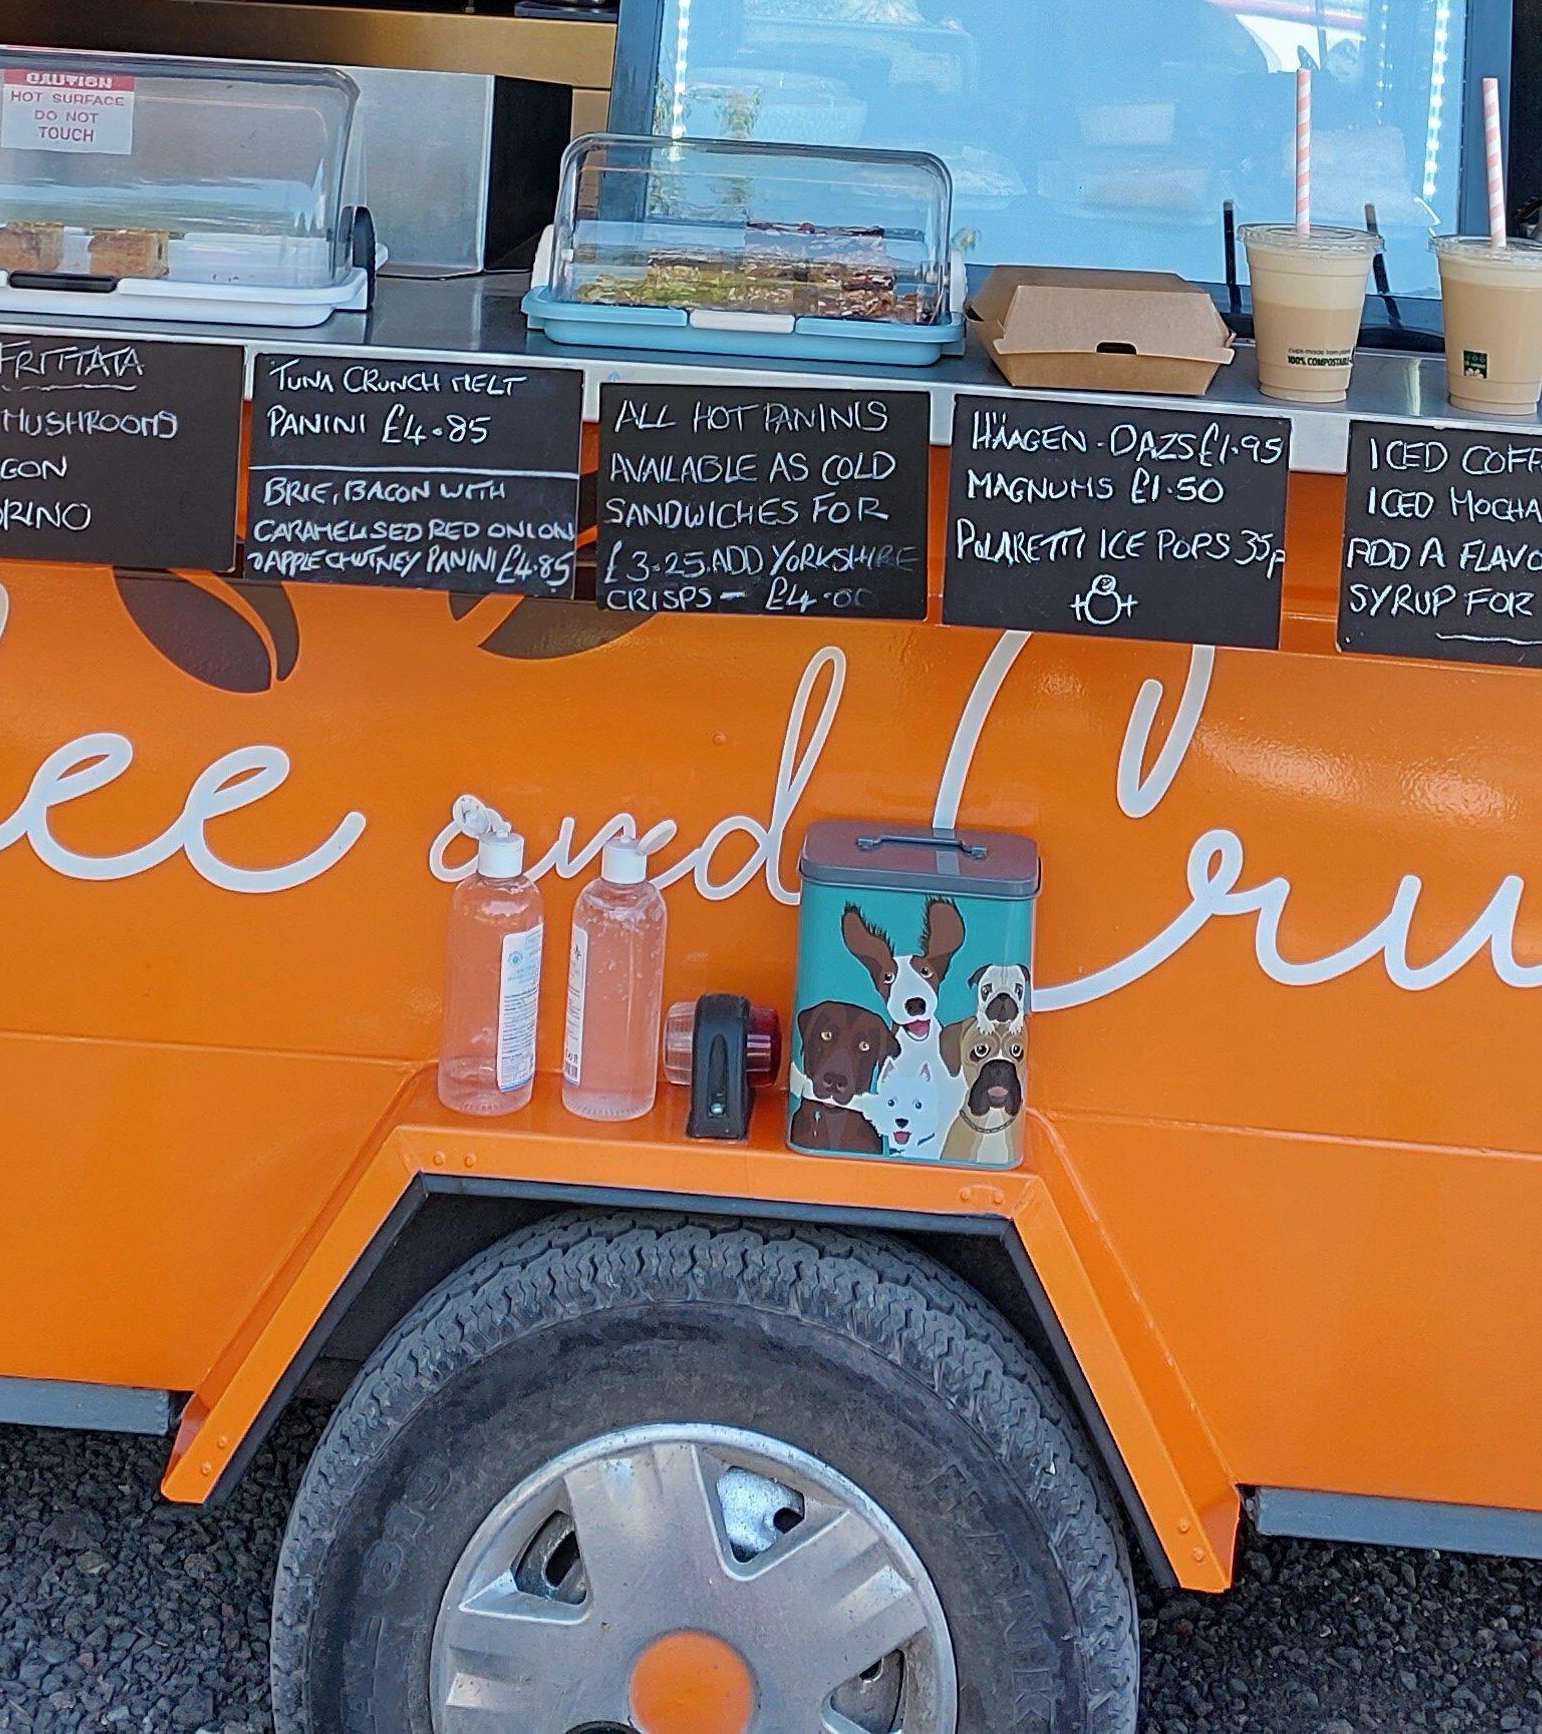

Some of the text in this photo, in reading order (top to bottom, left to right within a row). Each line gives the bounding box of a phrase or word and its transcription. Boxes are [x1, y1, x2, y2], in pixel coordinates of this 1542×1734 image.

[26, 72, 112, 89] CAUTION
[10, 90, 125, 107] HOT SURFACE
[34, 109, 99, 124] DO NOT
[38, 126, 95, 143] TOUCH
[268, 404, 490, 445] PANINI £4.85
[615, 400, 887, 433] ALL HOT PANINIS
[1371, 439, 1447, 472] ICED
[968, 468, 1223, 503] MAGNUMS £1.50
[606, 492, 888, 528] SANDWICHES FOR
[1351, 584, 1534, 617] SYRUP FOR
